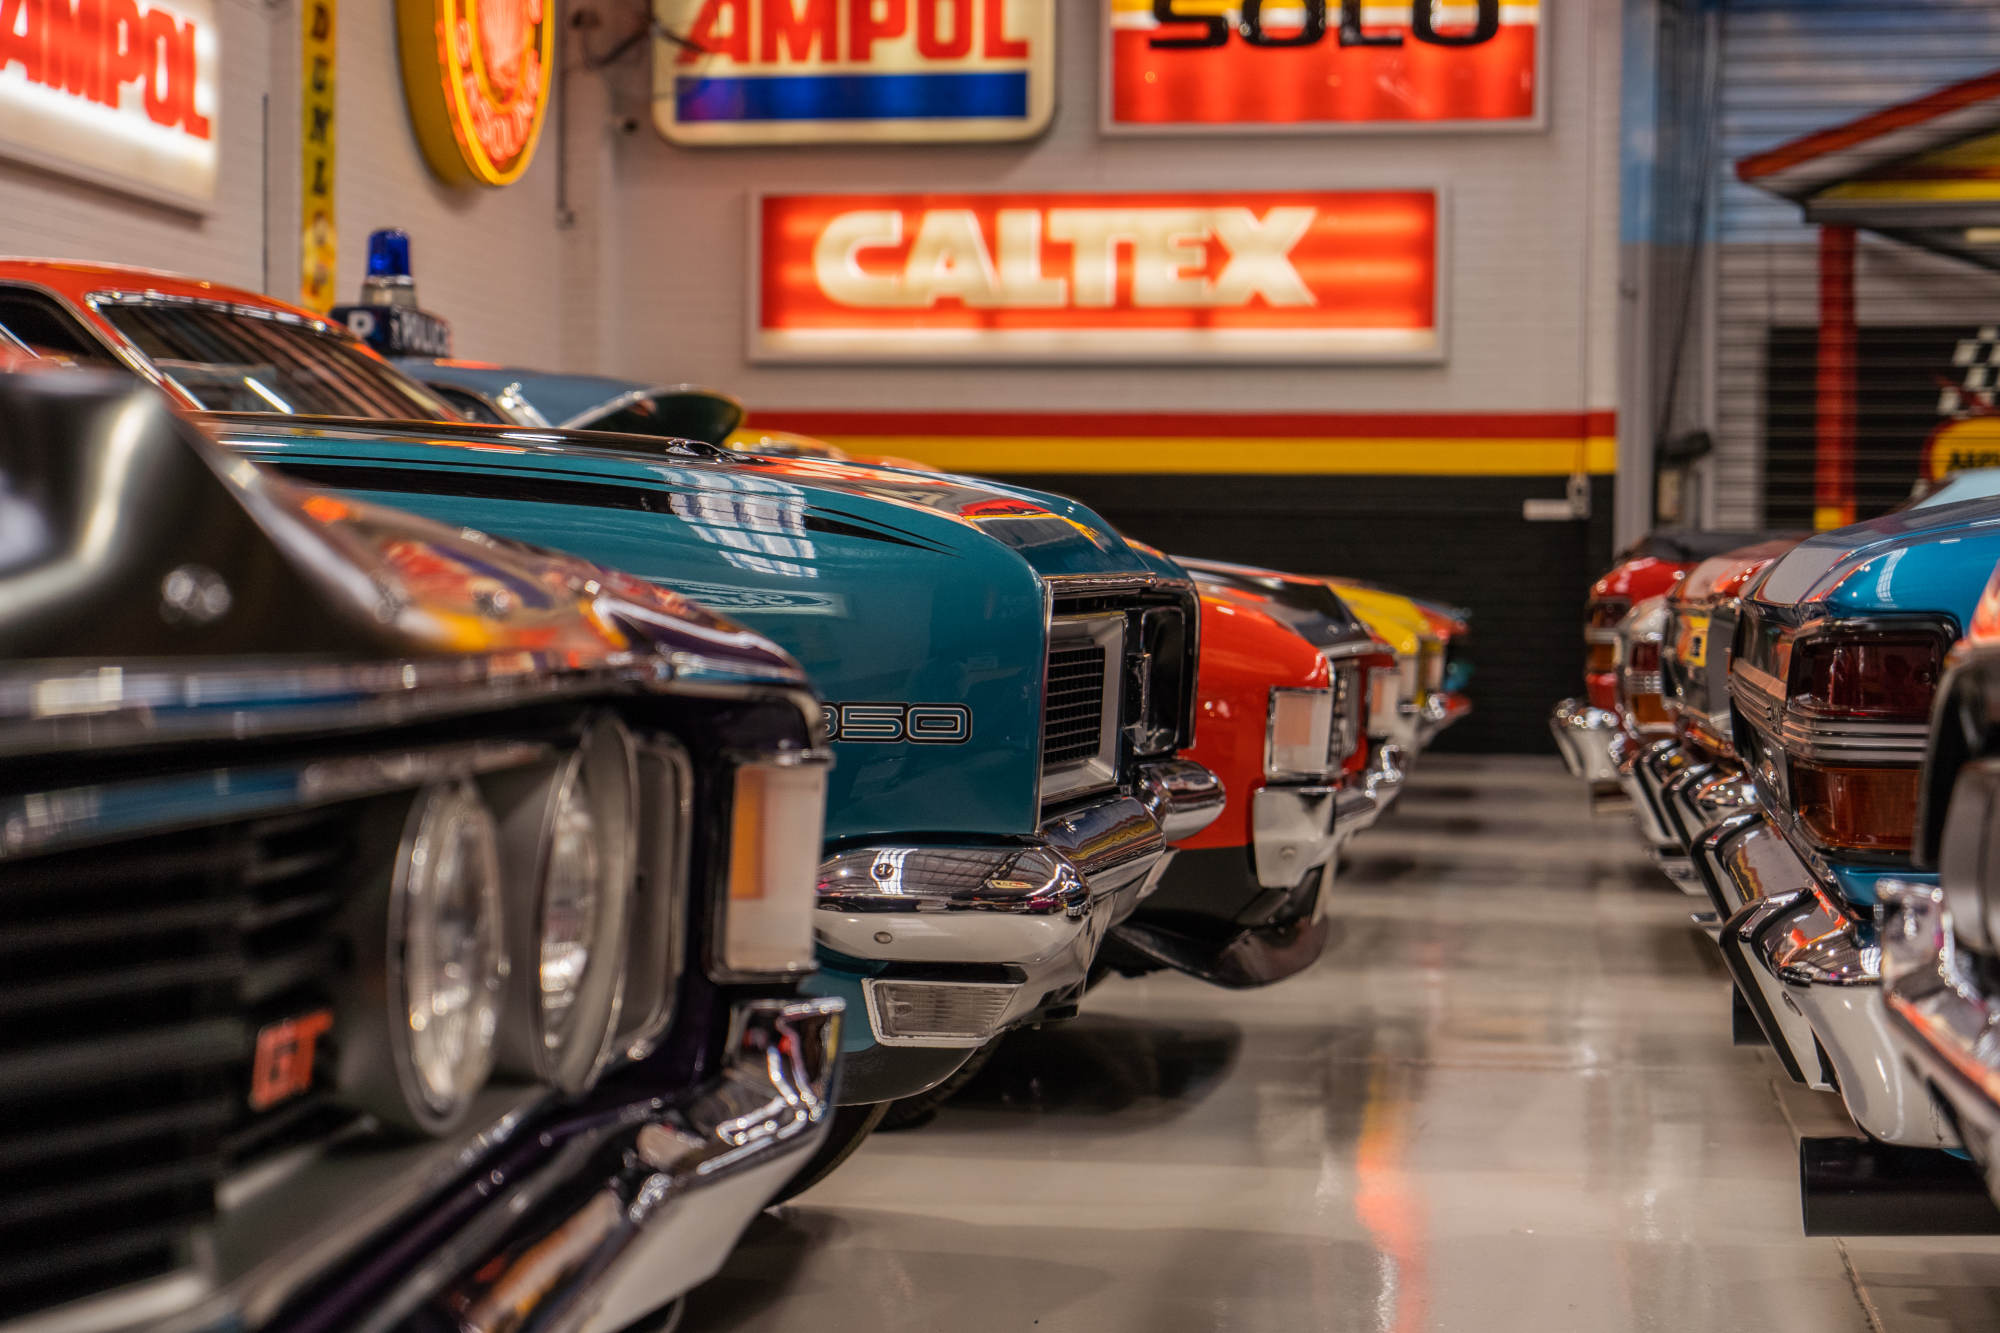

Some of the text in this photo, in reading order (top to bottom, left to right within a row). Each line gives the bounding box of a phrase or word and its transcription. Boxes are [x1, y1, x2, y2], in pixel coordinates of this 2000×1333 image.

[0, 0, 210, 140] AMPOL
[675, 0, 1030, 63] AMPOL
[1149, 0, 1500, 48] SOLO
[813, 207, 1318, 309] CALTEX
[249, 1010, 333, 1109] GT
